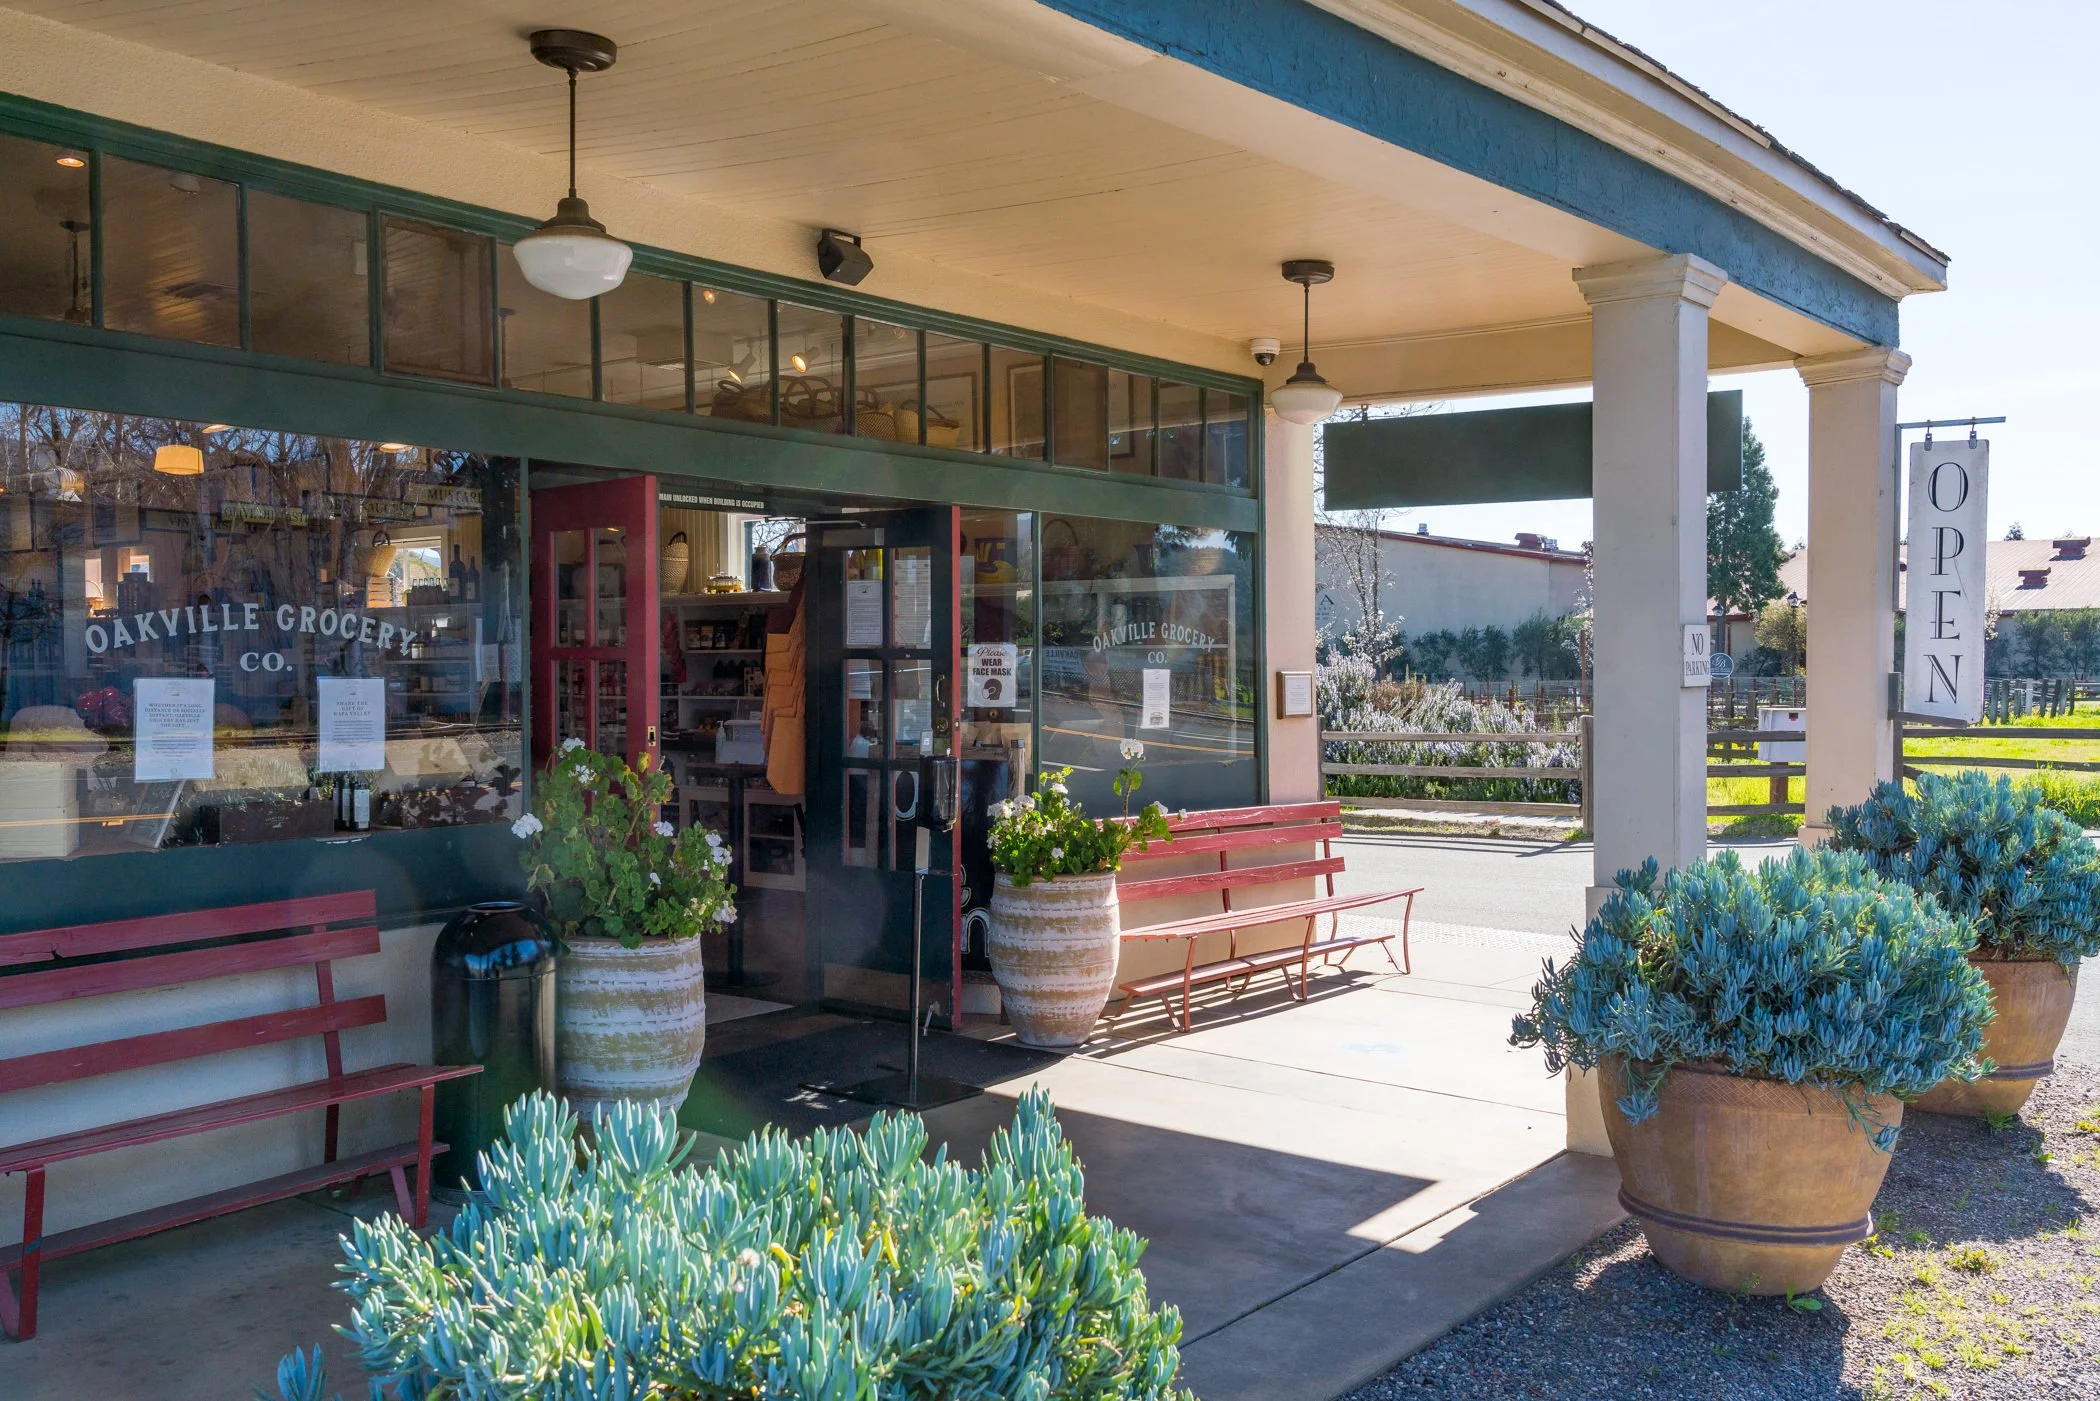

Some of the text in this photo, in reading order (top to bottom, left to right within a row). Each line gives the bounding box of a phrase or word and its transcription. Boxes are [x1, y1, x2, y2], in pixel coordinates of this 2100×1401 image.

[673, 494, 698, 504] UNLOCKED
[698, 496, 713, 505] WHEN
[713, 497, 736, 507] BUILDING
[735, 499, 741, 507] IS
[741, 500, 765, 509] OCCUPIED
[1923, 461, 1969, 705] OPEN
[85, 602, 419, 657] OAKVILLE GROCERY
[1092, 621, 1215, 653] OAKVILLE GROCERY
[976, 646, 1008, 657] Please
[1691, 632, 1704, 656] NO
[239, 652, 293, 672] CO.
[981, 658, 1003, 667] WEAR
[1147, 651, 1168, 664] CO.
[972, 667, 1012, 676] FACE MASK
[1685, 660, 1710, 677] PARKING
